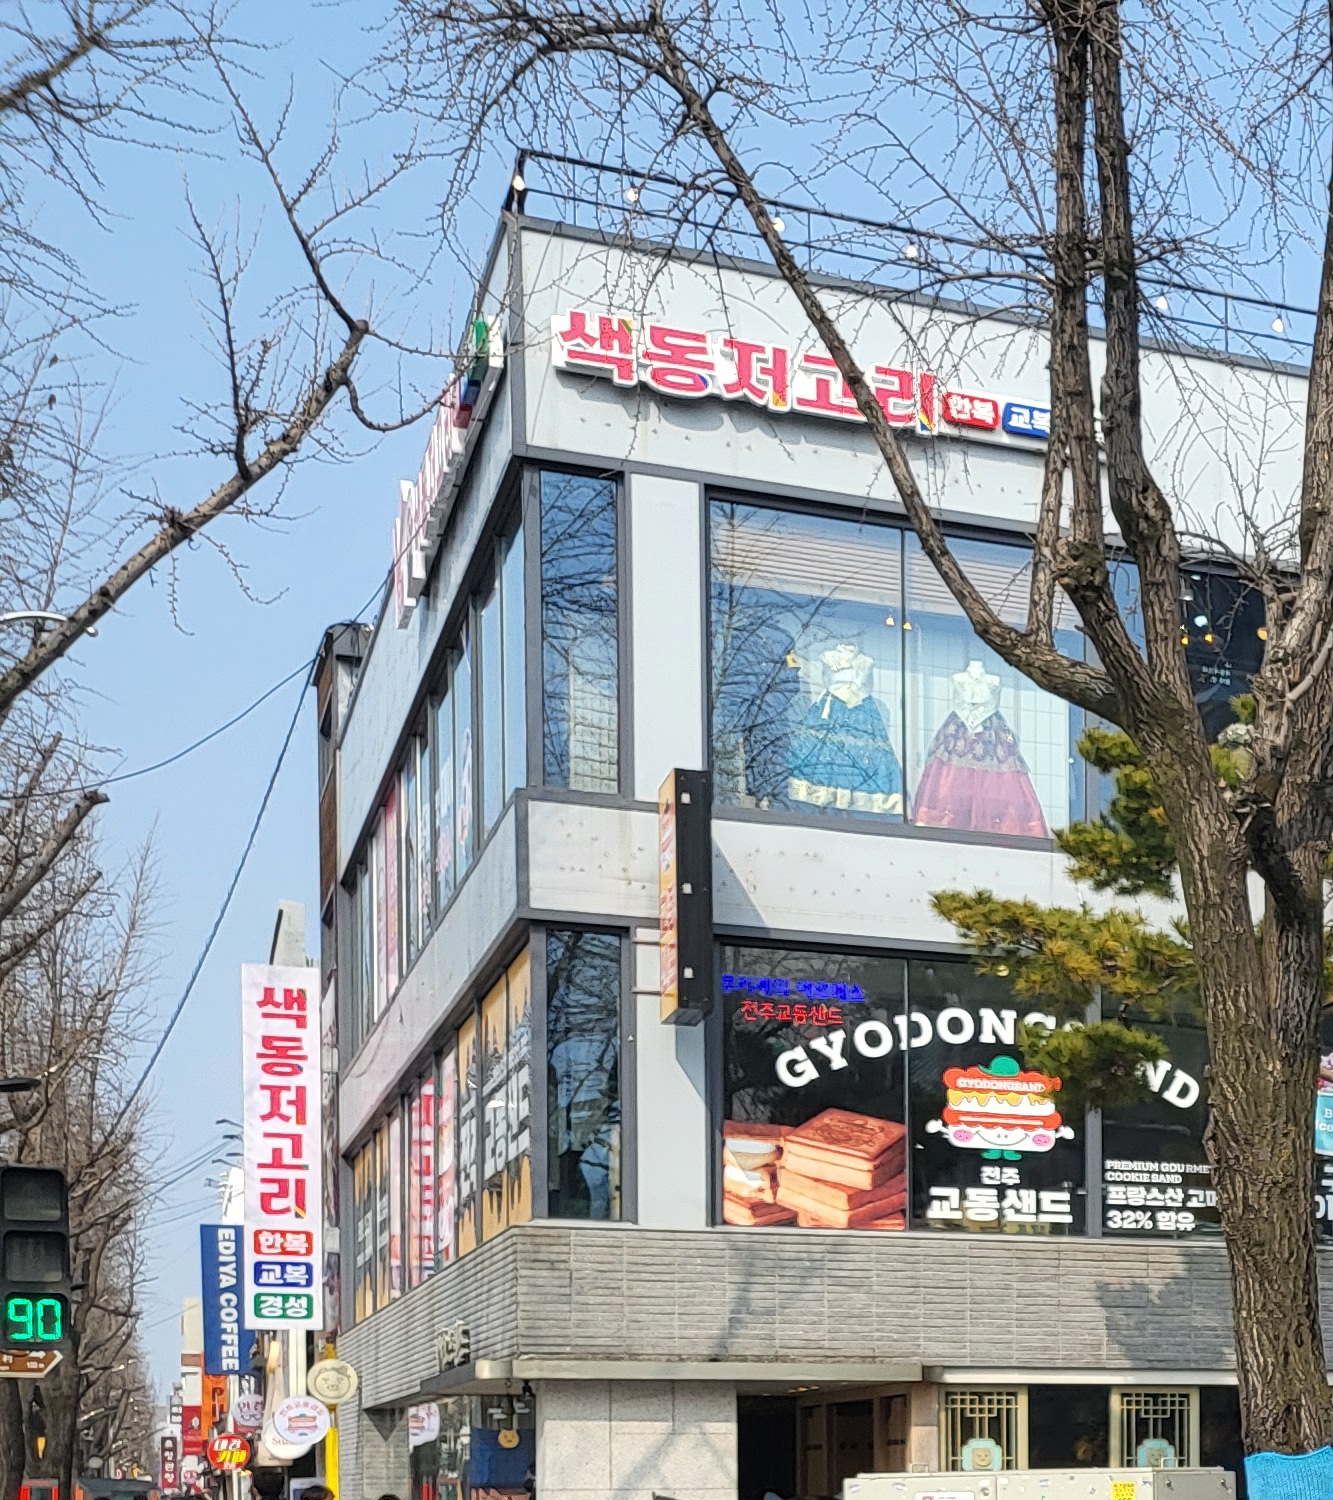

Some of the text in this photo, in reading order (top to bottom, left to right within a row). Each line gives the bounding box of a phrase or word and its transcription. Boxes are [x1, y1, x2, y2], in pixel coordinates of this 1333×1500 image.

[558, 311, 936, 432] 색동저고리
[949, 393, 996, 426] 한복
[740, 1000, 845, 1026] 전주교동샌드
[256, 987, 310, 1219] 색동저고리
[980, 1165, 1021, 1185] 전주
[1104, 1159, 1160, 1172] PREMIUM
[1104, 1171, 1183, 1184] COOKIE SAND
[926, 1186, 1074, 1224] 교동샌드
[1106, 1186, 1184, 1207] 프랑스산
[1106, 1209, 1196, 1231] 32% 함유
[258, 1233, 309, 1255] 한복
[258, 1263, 310, 1285] 교복
[217, 1227, 241, 1372] EDIYA COFFEE
[259, 1295, 308, 1318] 경성
[8, 1298, 63, 1341] 90
